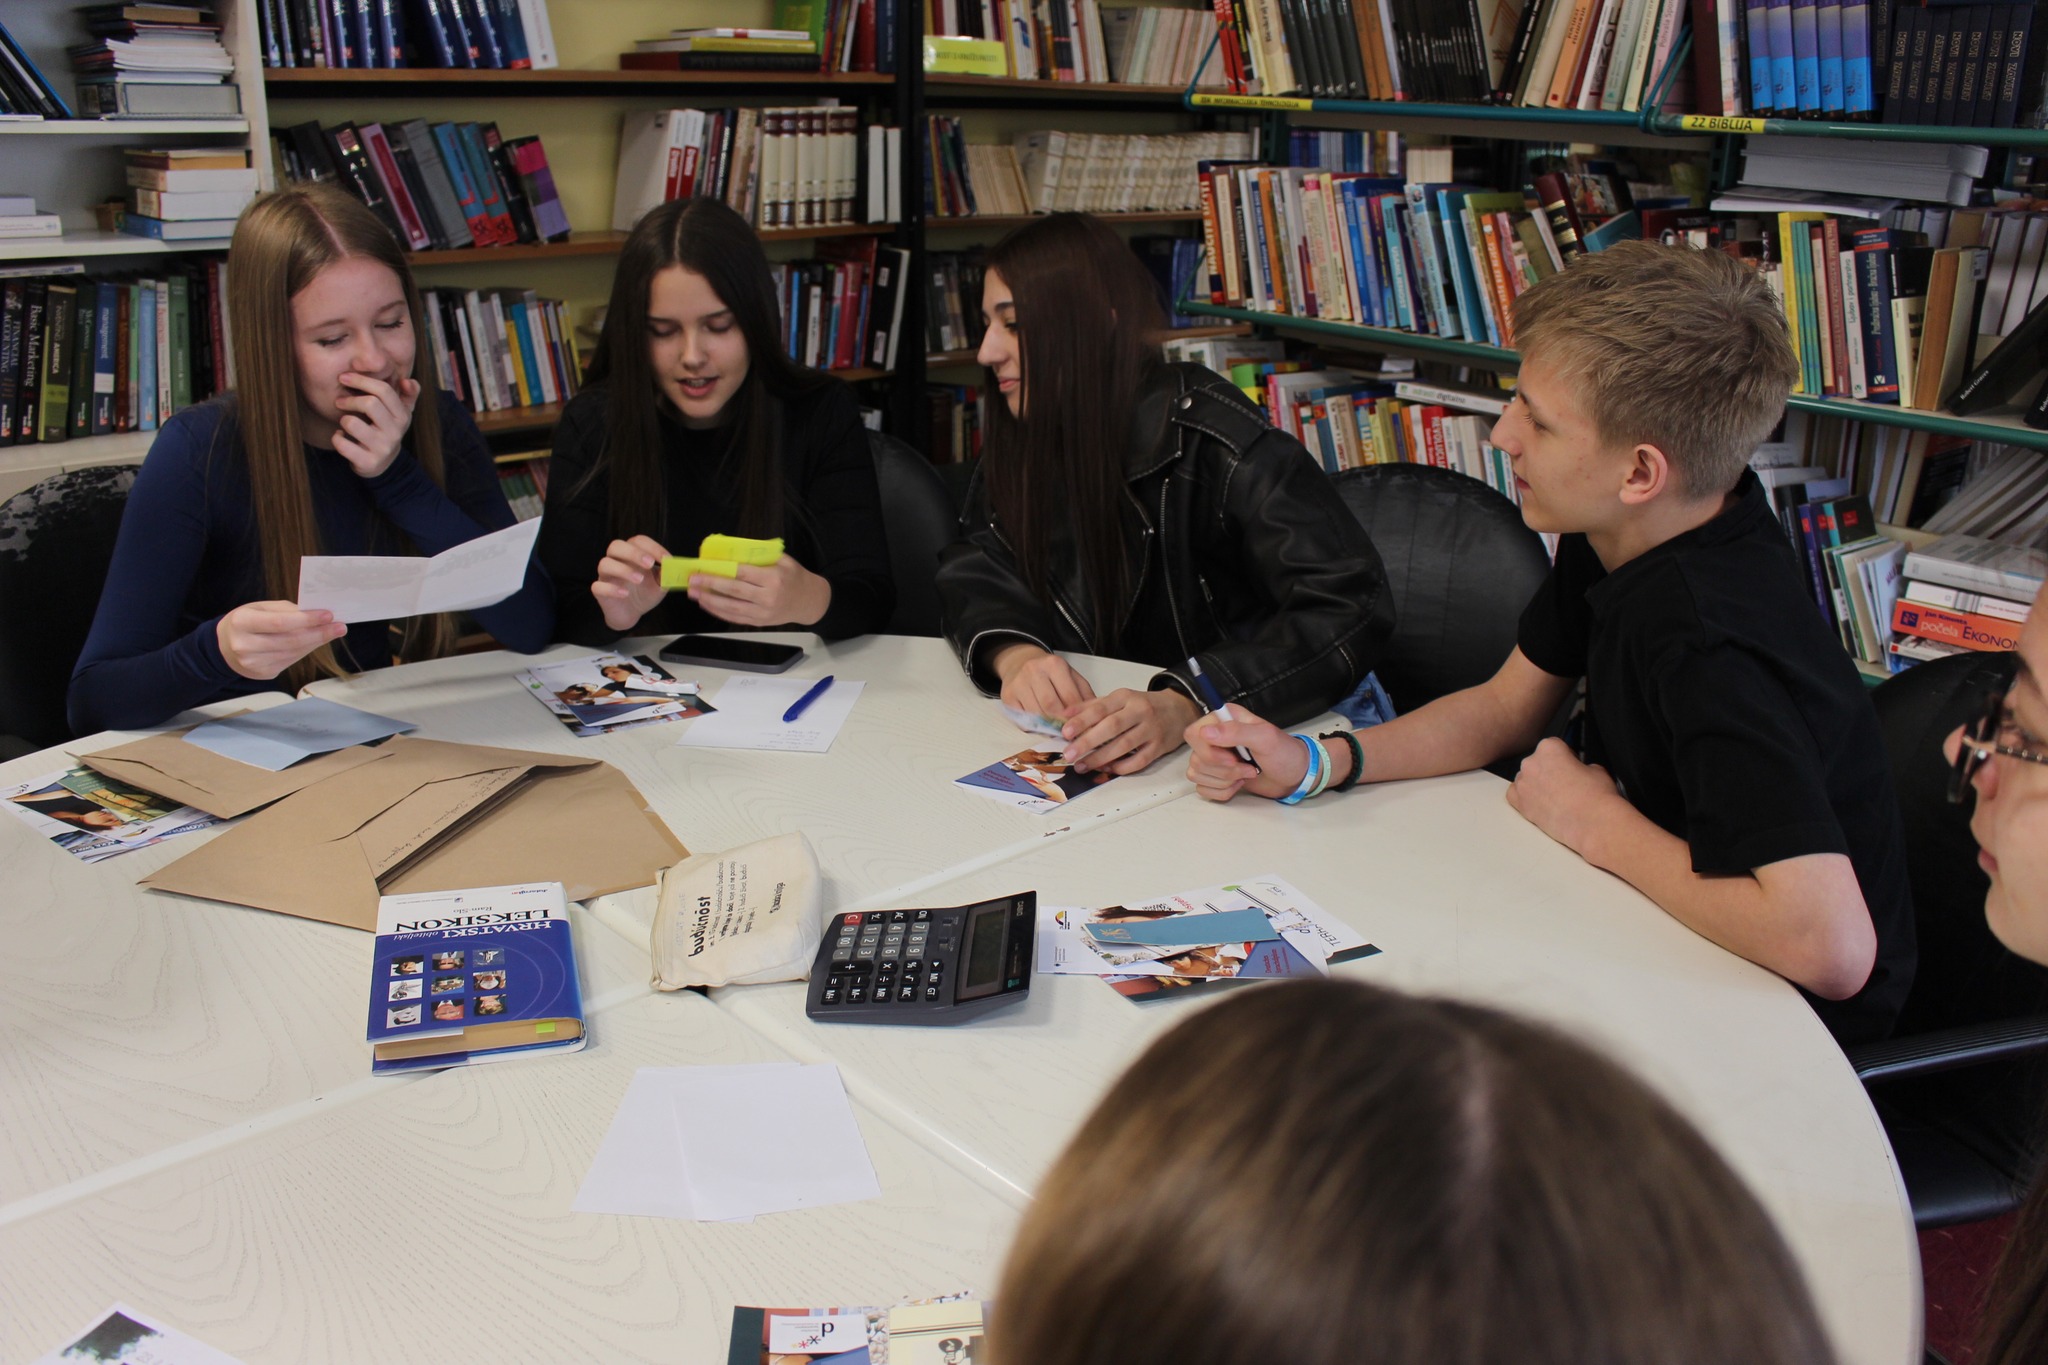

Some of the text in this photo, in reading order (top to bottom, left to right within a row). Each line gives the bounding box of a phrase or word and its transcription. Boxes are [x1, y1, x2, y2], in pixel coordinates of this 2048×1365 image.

[1691, 117, 1753, 131] 22 BIBLIJA
[99, 307, 110, 359] management
[1, 314, 12, 373] ACCOUNTING
[11, 321, 21, 366] FINANCIAL
[24, 304, 42, 387] Basic Marketing
[1920, 621, 1959, 638] počela
[894, 911, 905, 920] AC
[918, 910, 928, 919] ON
[1016, 901, 1024, 917] CASIO
[395, 909, 550, 932] LEKSIKON
[393, 921, 551, 941] HRVATSKI obiteljski
[839, 937, 851, 945] 00
[929, 973, 939, 983] MU
[901, 987, 911, 998] MC
[926, 987, 936, 996] GT
